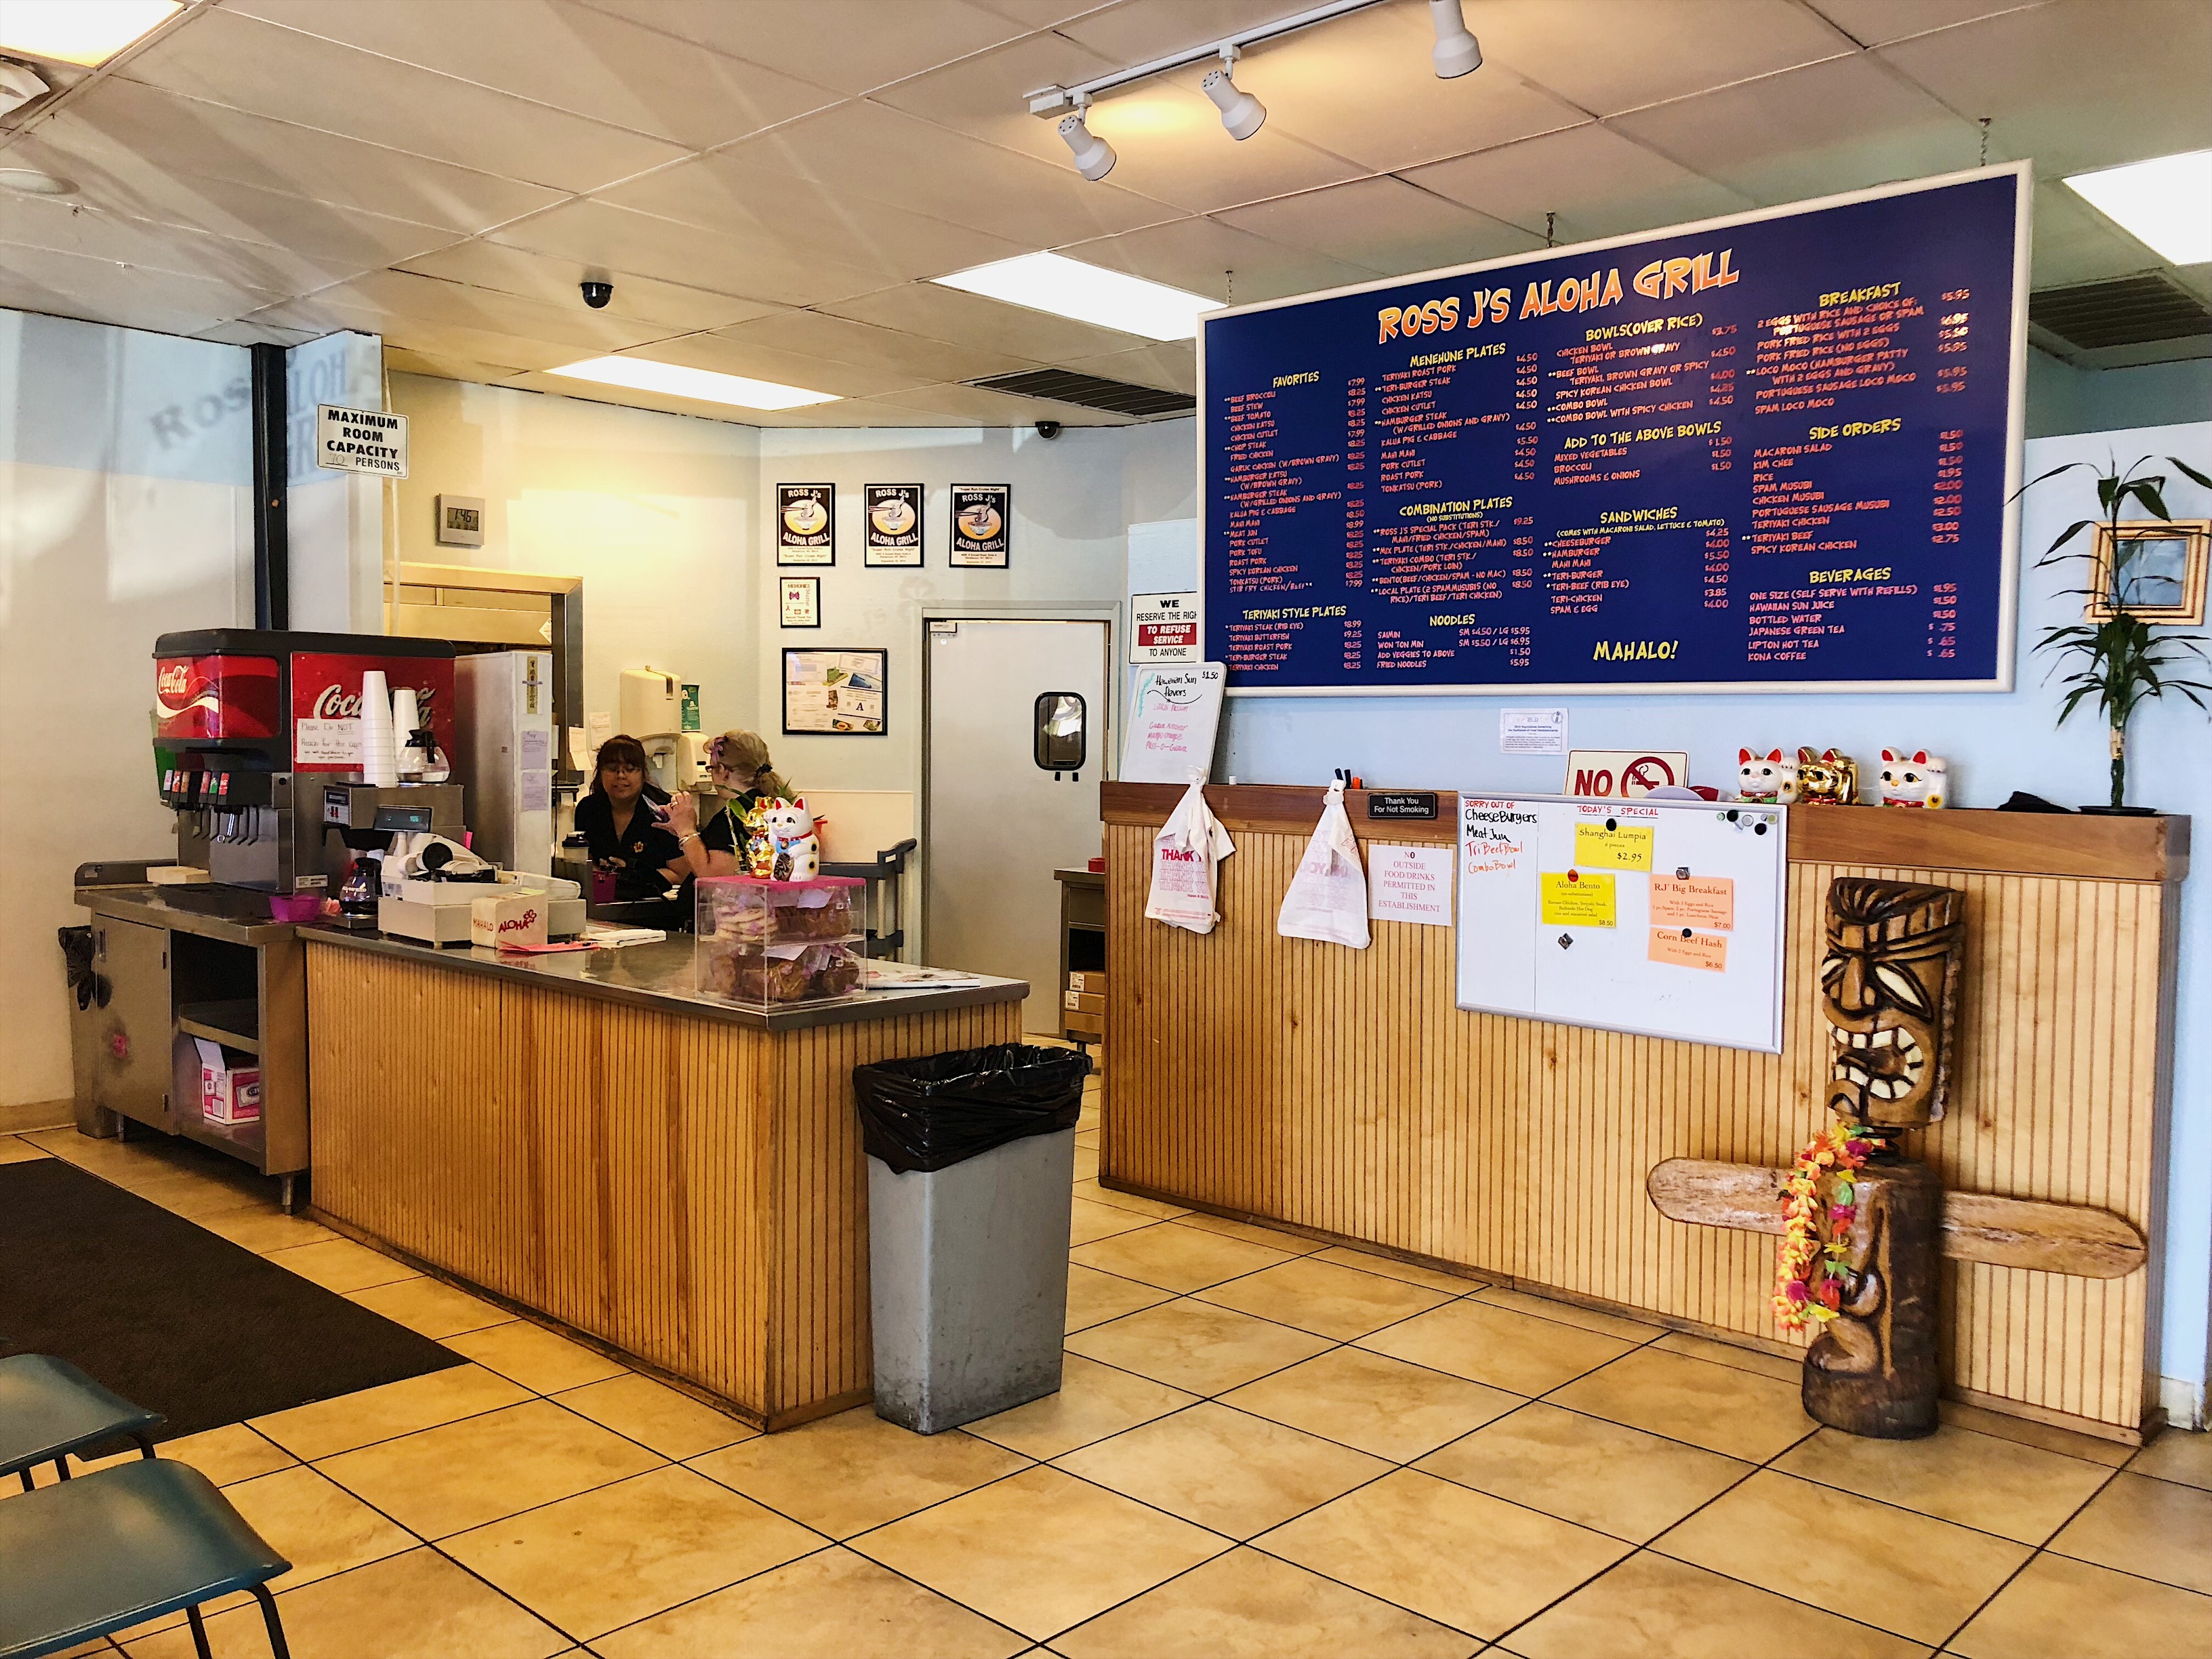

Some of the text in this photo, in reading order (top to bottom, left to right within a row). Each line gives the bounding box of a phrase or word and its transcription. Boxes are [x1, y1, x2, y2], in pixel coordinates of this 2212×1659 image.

[1378, 248, 1740, 344] ROSS J'S ALOHA GRILL
[1820, 282, 1901, 307] BREAKFAST
[1410, 343, 1506, 367] MENEHUNE PLATES
[1382, 365, 1456, 381] TERIYAKI ROAST PORK
[1273, 371, 1319, 388] FAVORITES
[1556, 377, 1673, 399] SPICY KOREAN CHICKEN BOWL
[1246, 403, 1263, 411] STEW
[328, 410, 398, 429] MAXIMUM
[343, 428, 383, 442] ROOM
[1564, 421, 1721, 449] ADD TO THE ABOVE BOWLS
[1809, 418, 1901, 440] SIDE ORDERS
[327, 441, 398, 459] CAPACITY
[1754, 443, 1832, 457] MACARONI SALAD
[356, 457, 399, 471] PERSONS
[1554, 462, 1591, 473] BROCCOLI
[1754, 458, 1793, 470] KIM CHEE
[788, 489, 808, 497] ROSS
[876, 489, 896, 497] ROSS
[962, 493, 983, 501] ROSS
[1399, 496, 1513, 516] COMBINATION PLATES
[1601, 507, 1677, 523] SANDWICHES
[783, 532, 830, 546] ALOHA GRILL
[871, 533, 918, 546] ALOHA GRILL
[956, 537, 1004, 550] ALOHA GRILL
[1809, 567, 1891, 583] BEVERAGES
[1160, 600, 1179, 608] WE
[1551, 594, 1602, 603] TERI-CHICKEN
[1750, 601, 1834, 612] HAWAIIAN SUN JUICE
[1136, 613, 1165, 621] RESERVE
[1243, 606, 1346, 620] TERIYAKI STYLE PLATES
[1430, 614, 1475, 626] NOODLES
[1147, 625, 1191, 634] TO REFUSE
[1153, 635, 1183, 644] SERVICE
[1160, 648, 1186, 656] ANYONE
[1593, 640, 1678, 661] MAHALO!
[1748, 652, 1806, 661] KONA COFFEE
[1397, 660, 1427, 668] NOODLES
[1185, 674, 1196, 684] Sun
[856, 702, 864, 711] A
[1574, 769, 1613, 796] NO
[1399, 806, 1429, 814] Smoking
[1465, 800, 1489, 808] SORRY
[1577, 805, 1612, 813] TODAY'S
[1467, 824, 1488, 838] Meat
[1579, 827, 1646, 842] Shanghai Lumpia
[1162, 849, 1193, 861] THANK
[1617, 853, 1642, 862] $2.95
[1393, 861, 1426, 869] OUTSIDE
[1160, 879, 1193, 892] THANK
[1383, 880, 1425, 890] PERMITTED
[1673, 884, 1686, 894] Big
[1689, 885, 1727, 895] Breakfast
[1401, 892, 1418, 900] THIS
[1378, 901, 1441, 912] ESTABLISHMENT
[473, 918, 493, 931] MAHALO
[498, 920, 529, 933] ALOHA
[1657, 931, 1721, 947] Corn Beef Hash
